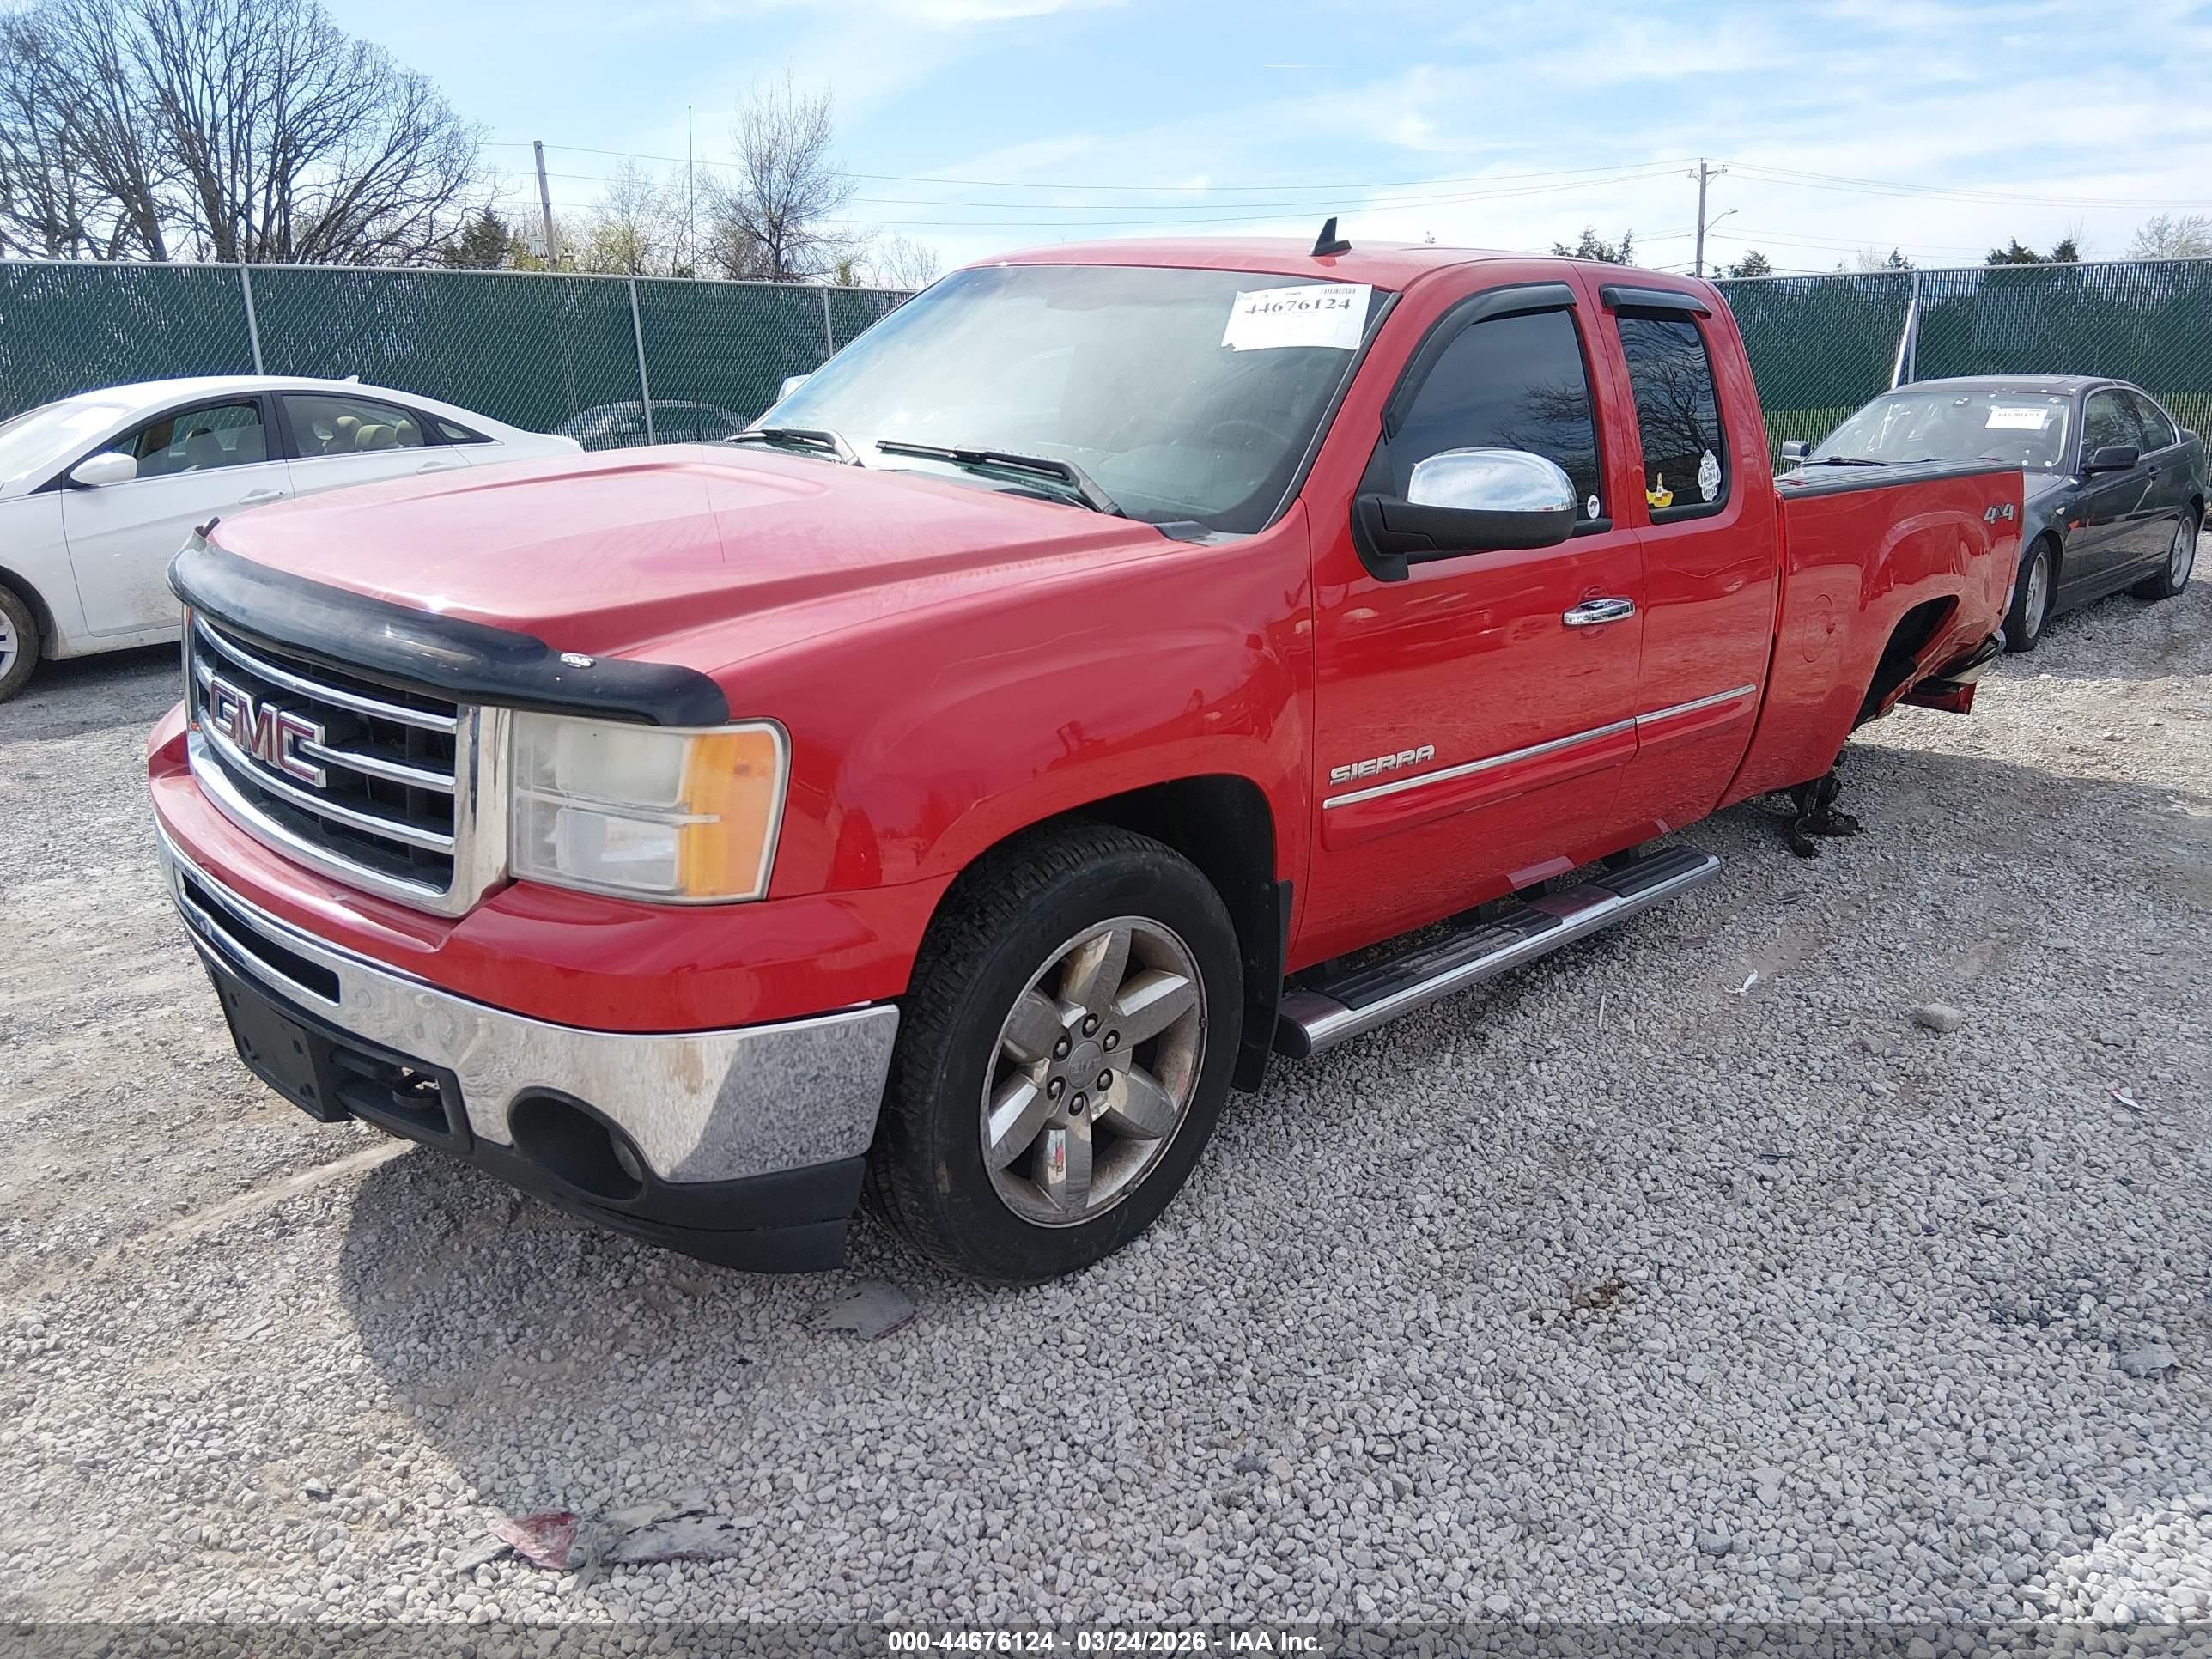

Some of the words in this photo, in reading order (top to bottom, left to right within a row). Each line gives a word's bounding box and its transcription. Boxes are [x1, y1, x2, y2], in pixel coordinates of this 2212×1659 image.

[1245, 298, 1351, 314] 44676124
[210, 676, 327, 788] GMC
[1330, 744, 1435, 787] SIERRA
